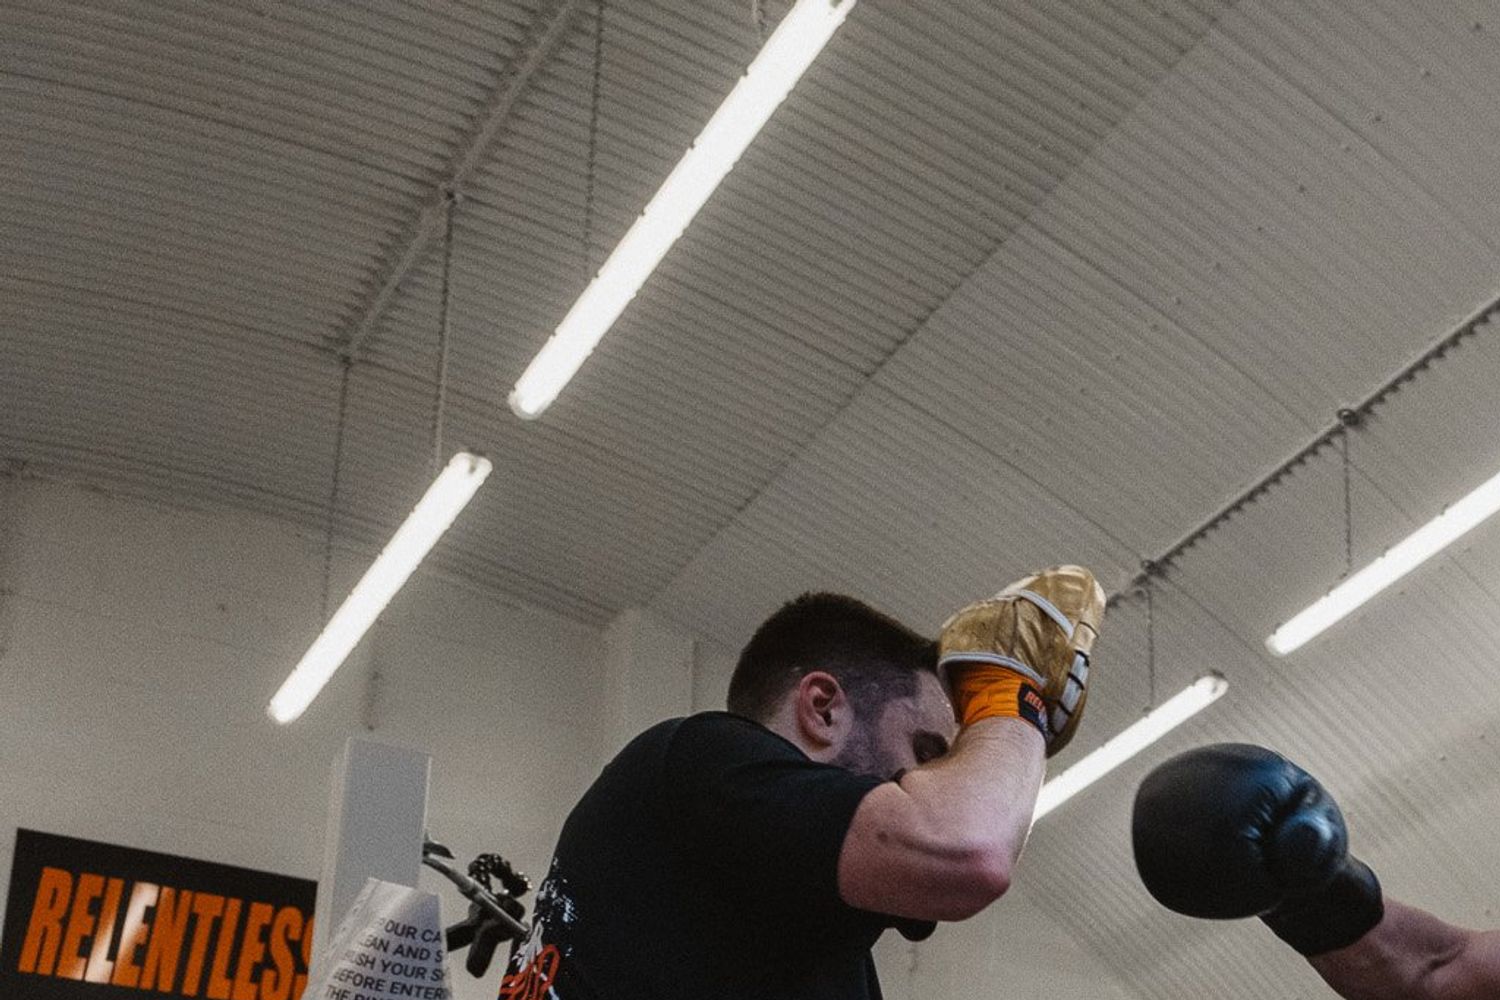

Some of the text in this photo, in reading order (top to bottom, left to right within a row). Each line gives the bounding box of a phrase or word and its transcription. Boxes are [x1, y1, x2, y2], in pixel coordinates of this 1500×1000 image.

[393, 943, 431, 961] AND
[380, 957, 428, 980] YOUR
[390, 981, 448, 1000] ENTER
